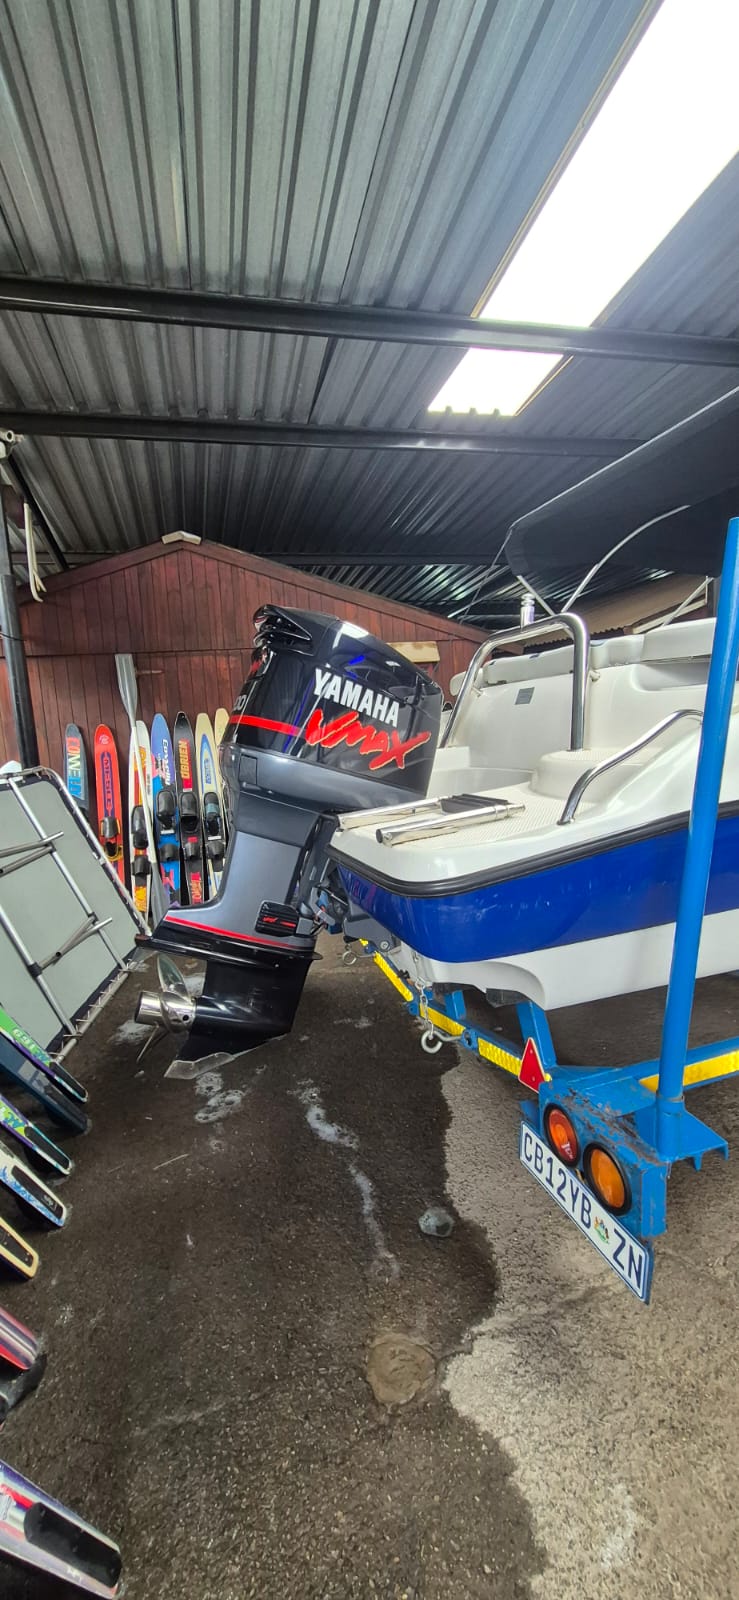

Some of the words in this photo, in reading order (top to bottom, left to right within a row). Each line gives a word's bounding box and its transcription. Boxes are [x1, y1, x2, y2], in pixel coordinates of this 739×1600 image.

[314, 668, 400, 727] YAMAHA
[65, 737, 82, 799] CONNELLY
[524, 1132, 592, 1230] CB12YB
[612, 1228, 643, 1289] ZN
